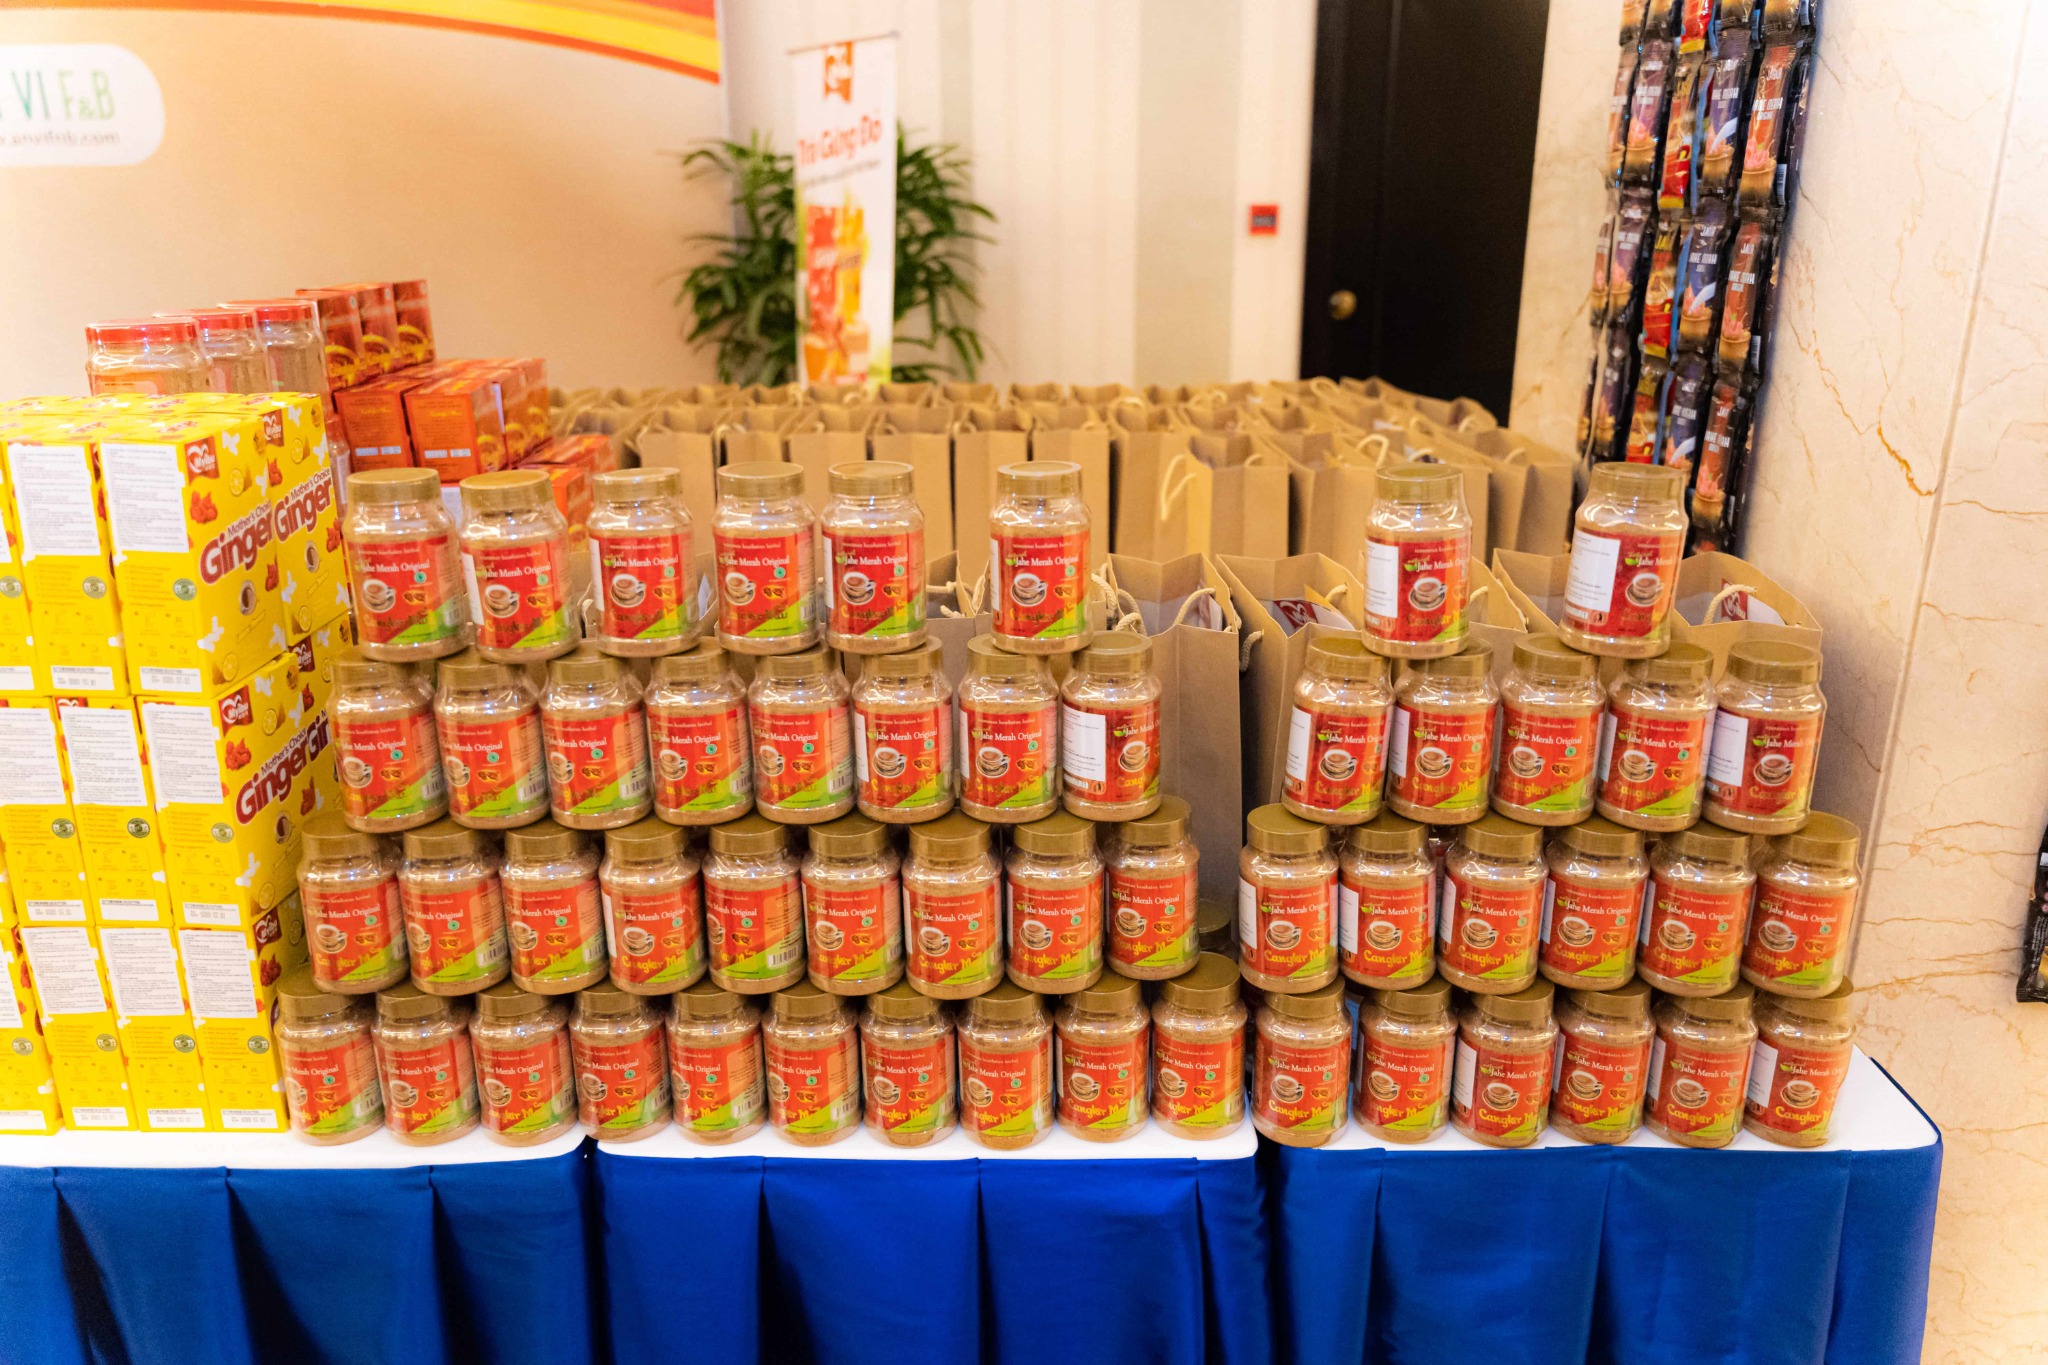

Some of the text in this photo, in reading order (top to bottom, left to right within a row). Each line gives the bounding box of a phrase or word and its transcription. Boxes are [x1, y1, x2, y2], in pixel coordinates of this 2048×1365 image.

[290, 467, 331, 501] Mother's Choice
[274, 476, 333, 543] Ginger
[200, 510, 273, 585] Ginger
[401, 560, 430, 573] Original
[629, 557, 651, 567] Merah
[762, 556, 789, 569] Original
[860, 555, 881, 566] Merah
[1016, 558, 1030, 568] Jahe
[1031, 557, 1053, 567] Merah
[524, 565, 551, 578] Original
[579, 736, 607, 750] Original
[694, 733, 721, 746] Original
[791, 731, 818, 744] Original
[876, 731, 890, 741] Jahe
[891, 732, 912, 742] Merah
[980, 731, 994, 742] Jahe
[995, 732, 1016, 742] Merah
[1328, 734, 1366, 744] Jahe Merah
[1440, 733, 1462, 743] Merah
[1515, 731, 1582, 747] Jahe Merah Original
[1644, 735, 1666, 746] Merah
[377, 737, 407, 752] Original
[474, 740, 503, 754] Original
[236, 738, 309, 825] Ginger
[1119, 893, 1180, 906] Jahe Merah Original
[352, 903, 381, 919] Original
[436, 909, 464, 923] Original
[543, 904, 571, 918] Original
[638, 912, 660, 922] Merah
[661, 907, 686, 921] Original
[731, 905, 757, 918] Original
[829, 905, 876, 918] Merah Original
[935, 913, 956, 923] Merah
[957, 909, 983, 923] Original
[1038, 906, 1059, 916] Merah
[1060, 904, 1086, 917] Original
[1271, 906, 1309, 916] Jahe Merah
[1371, 906, 1409, 916] Jahe Merah
[1470, 904, 1484, 914] Jahe
[1486, 907, 1507, 918] Merah
[1566, 902, 1632, 917] Jahe Merah Original
[1667, 904, 1682, 915] Jahe
[1683, 908, 1707, 919] Merah
[1769, 904, 1838, 926] Jahe Merah Original
[424, 1060, 450, 1074] Original
[495, 1060, 544, 1077] Merah Original
[592, 1059, 639, 1073] Merah Original
[887, 1062, 933, 1076] Merah Original
[1073, 1058, 1085, 1069] Jahe
[1086, 1062, 1107, 1072] Merah
[1174, 1058, 1194, 1070] Merah
[1195, 1060, 1221, 1073] Original
[1276, 1060, 1338, 1074] Jahe Merah Original
[1387, 1061, 1408, 1073] Merah
[1410, 1063, 1435, 1076] Original
[1576, 1054, 1591, 1066] Jahe
[1592, 1060, 1613, 1072] Merah
[1791, 1064, 1808, 1075] Jahe
[310, 1064, 339, 1078] Original
[694, 1064, 721, 1077] Original
[795, 1066, 822, 1079] Original
[980, 1068, 999, 1079] Merah
[1000, 1068, 1026, 1081] Original
[1490, 1068, 1529, 1080] Jahe Merah
[1681, 1064, 1719, 1078] Jahe Merah
